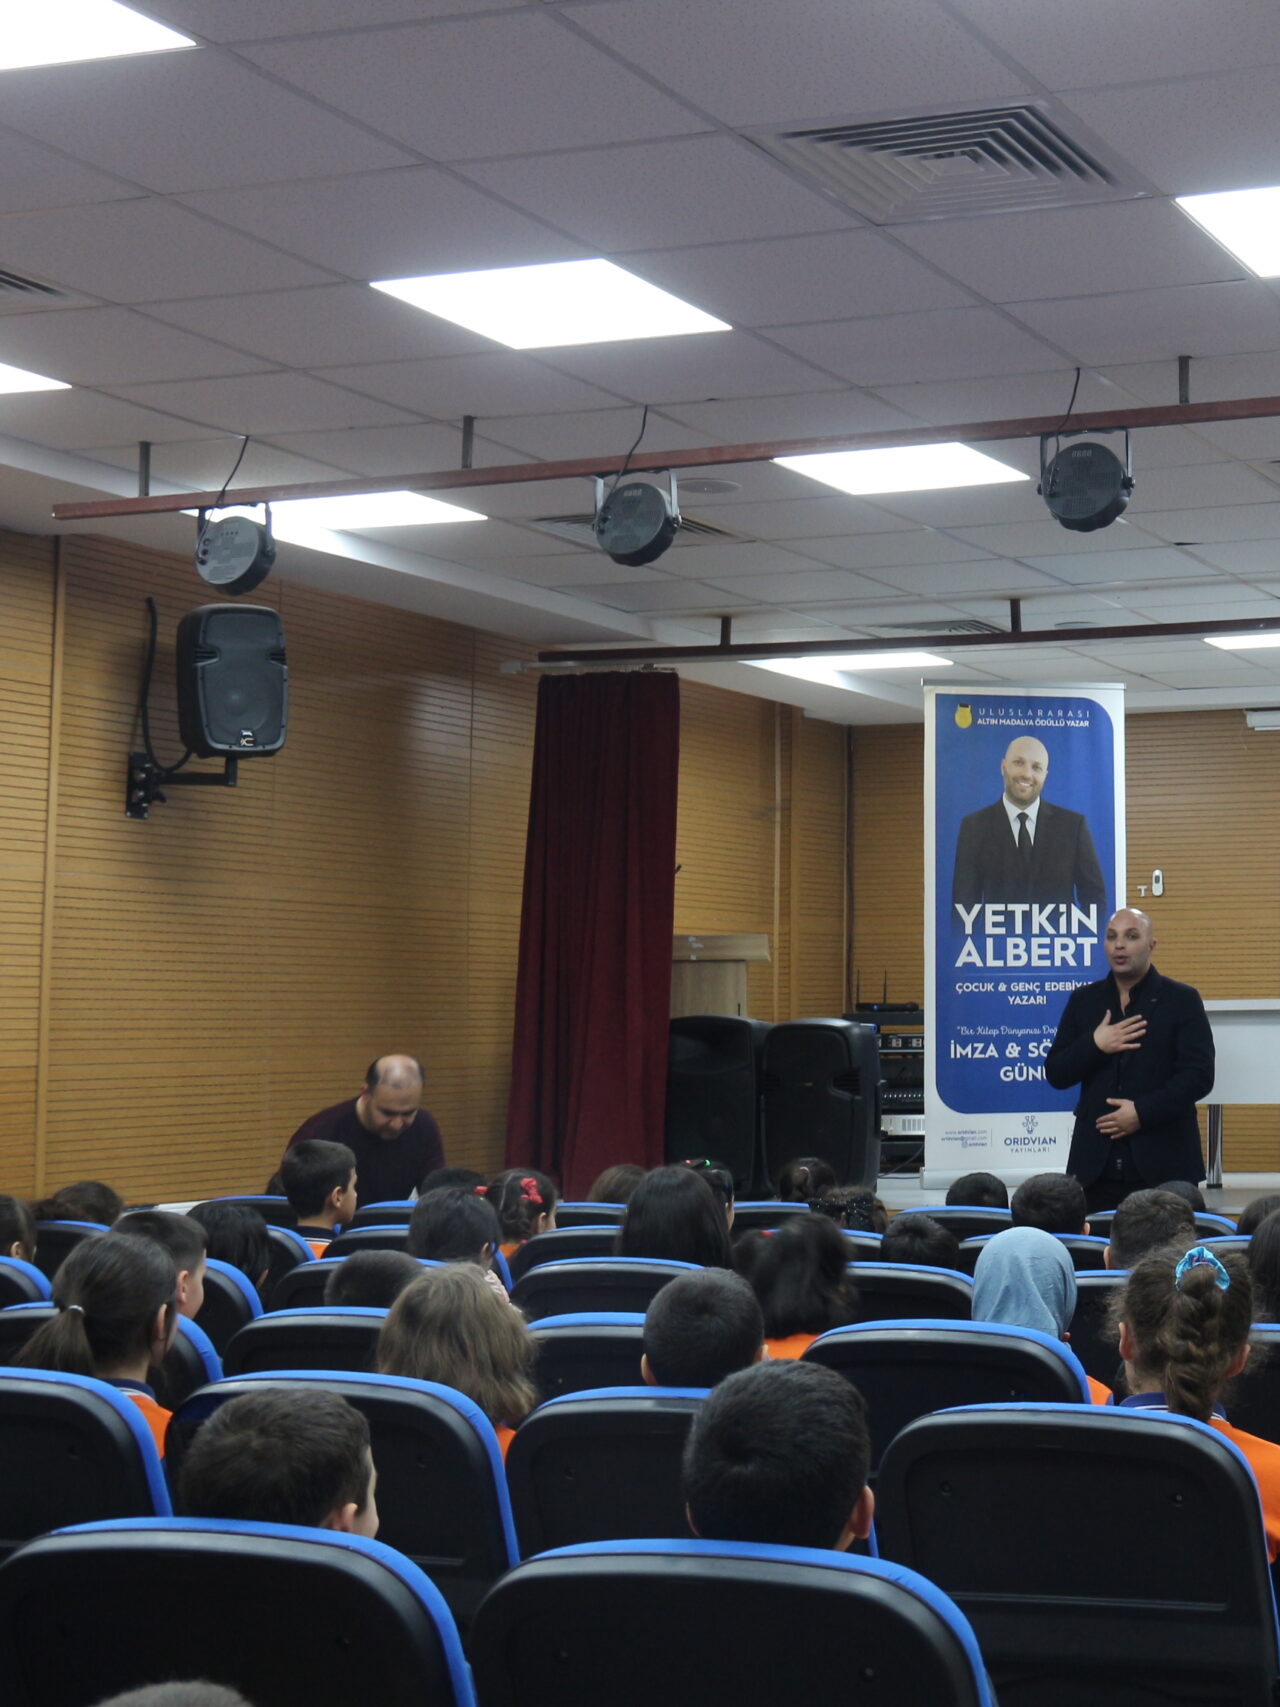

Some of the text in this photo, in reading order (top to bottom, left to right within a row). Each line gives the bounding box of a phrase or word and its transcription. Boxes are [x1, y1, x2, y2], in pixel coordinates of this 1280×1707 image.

[979, 708, 1090, 717] ULUSLARARASI
[977, 717, 1090, 728] ALTIN MADALYA ÖDÜLLÜ YAZAR
[954, 936, 1098, 968] ALBERT
[955, 982, 995, 994] ÇOCUK
[998, 982, 1007, 992] &
[1010, 982, 1041, 994] GENÇ
[1007, 995, 1047, 1005] YAZARI
[950, 1039, 999, 1059] İMZA
[1005, 1042, 1021, 1058] &
[1004, 1136, 1057, 1147] ORIDVIAN
